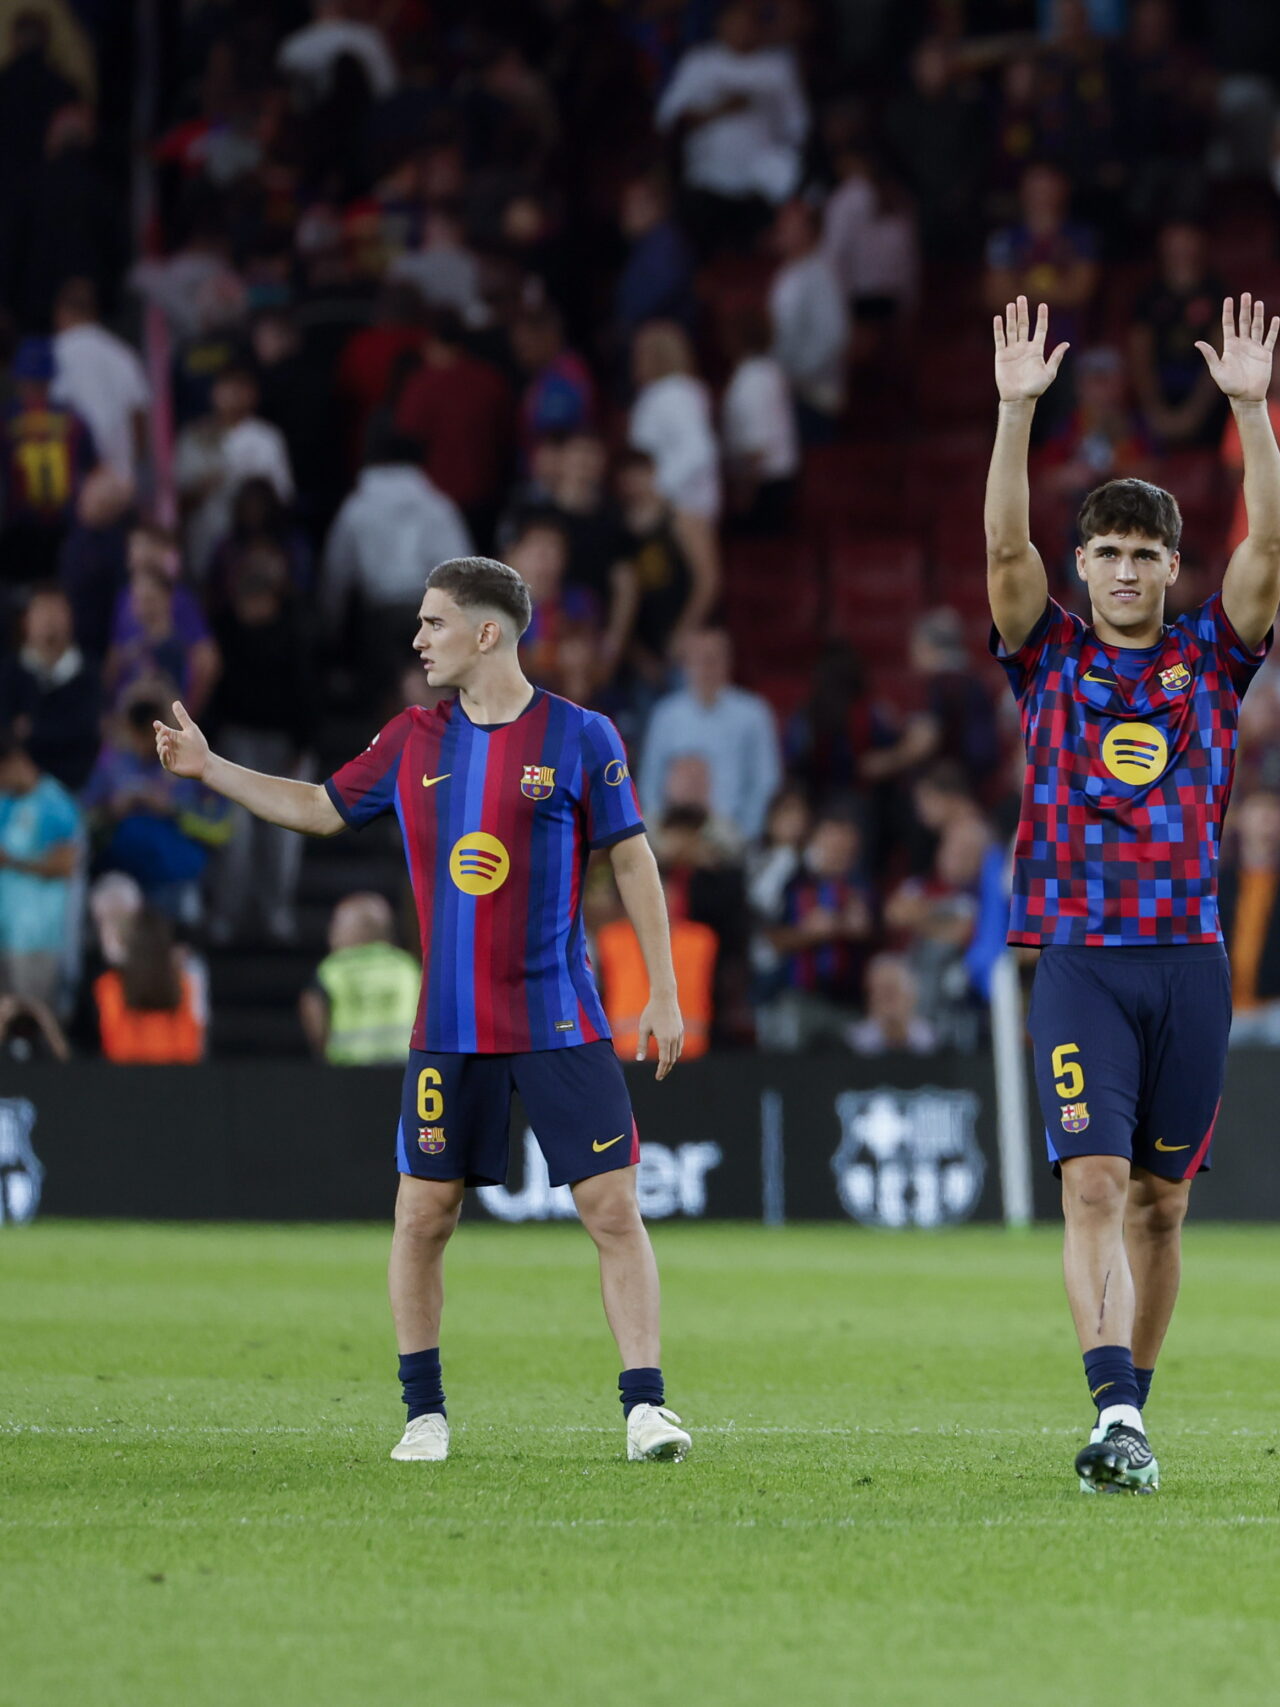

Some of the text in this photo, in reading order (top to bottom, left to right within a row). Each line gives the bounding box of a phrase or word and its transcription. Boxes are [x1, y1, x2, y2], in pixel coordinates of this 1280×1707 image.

[417, 1067, 443, 1121] 6
[1051, 1043, 1085, 1099] 5
[476, 1127, 722, 1220] Uer
